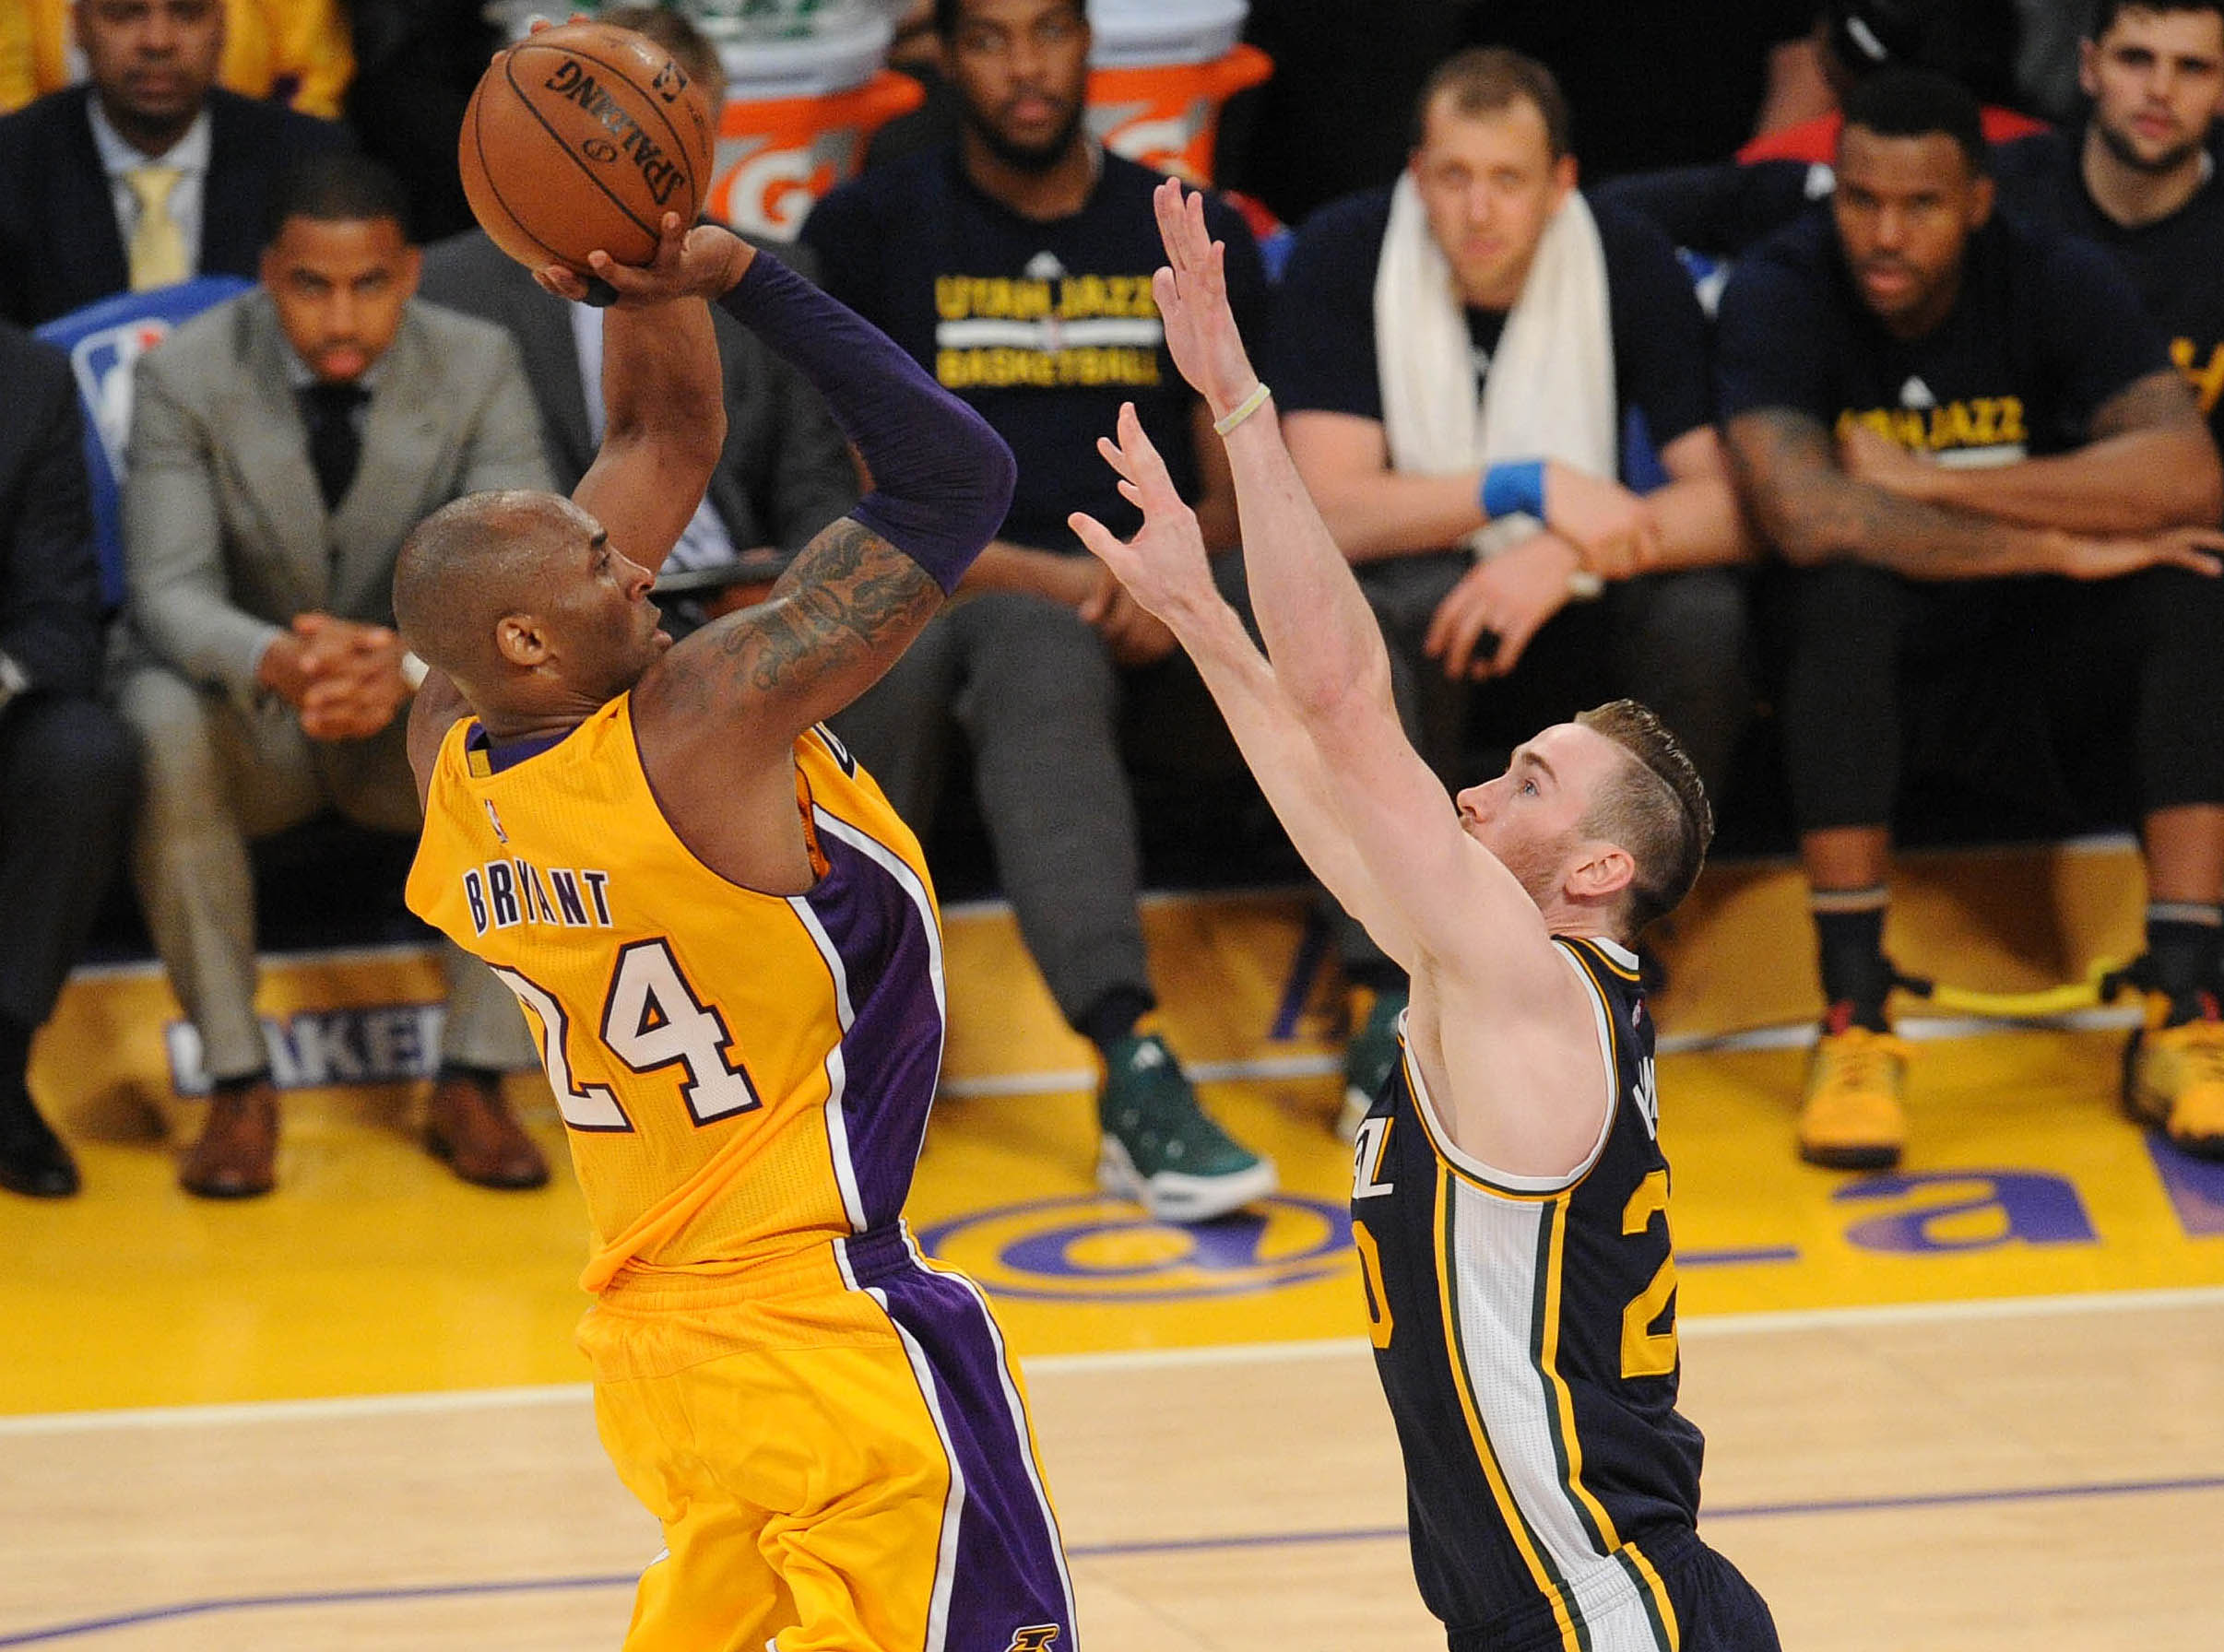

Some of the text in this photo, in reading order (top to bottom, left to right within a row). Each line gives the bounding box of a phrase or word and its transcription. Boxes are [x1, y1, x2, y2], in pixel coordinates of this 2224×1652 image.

[545, 61, 685, 206] SPALDING
[935, 276, 1160, 320] UTAH JAZZ
[936, 347, 1159, 387] BASKETBALL
[1931, 396, 2026, 450] JAZZ
[463, 856, 613, 938] BRYANT
[470, 936, 763, 1133] 24
